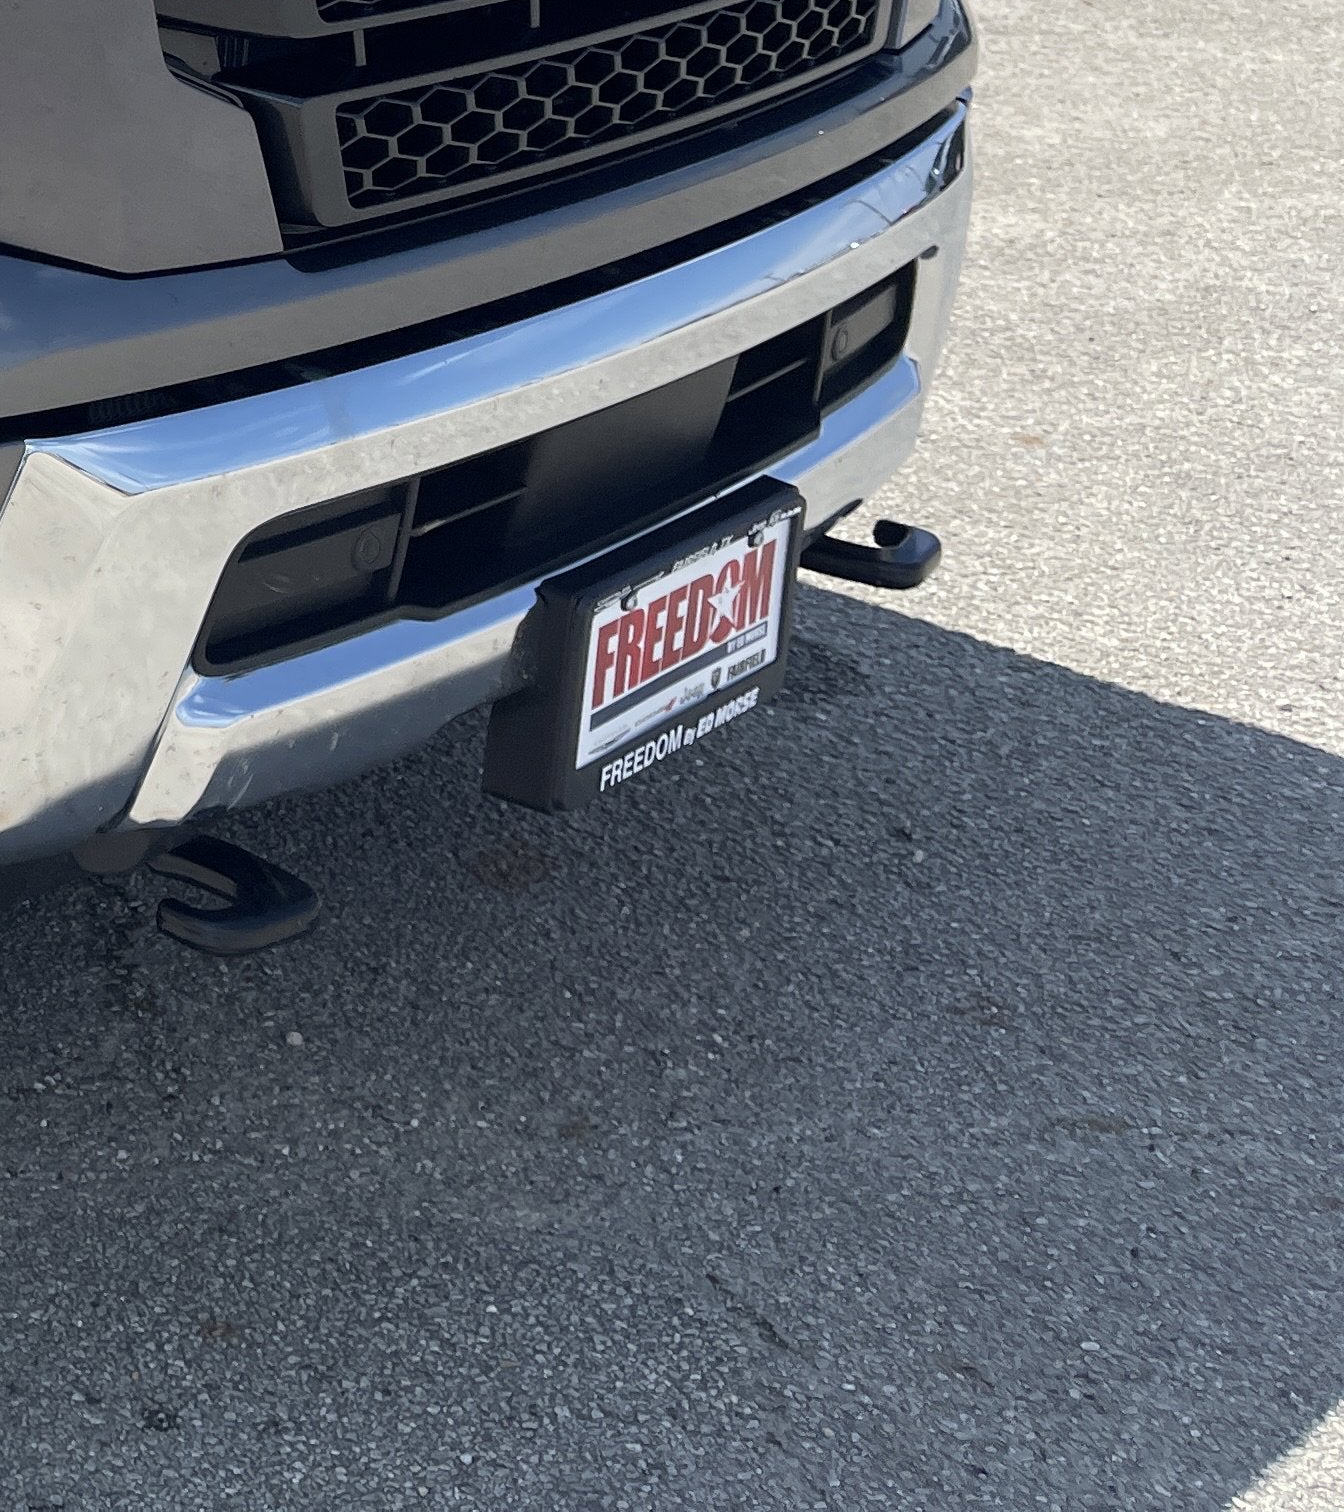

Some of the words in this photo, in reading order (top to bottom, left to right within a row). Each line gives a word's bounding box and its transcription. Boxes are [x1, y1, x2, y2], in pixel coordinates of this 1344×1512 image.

[592, 539, 777, 711] FREEDOM
[599, 724, 684, 792] FREEDOM
[696, 712, 715, 739] ED
[714, 686, 760, 729] MORSE
